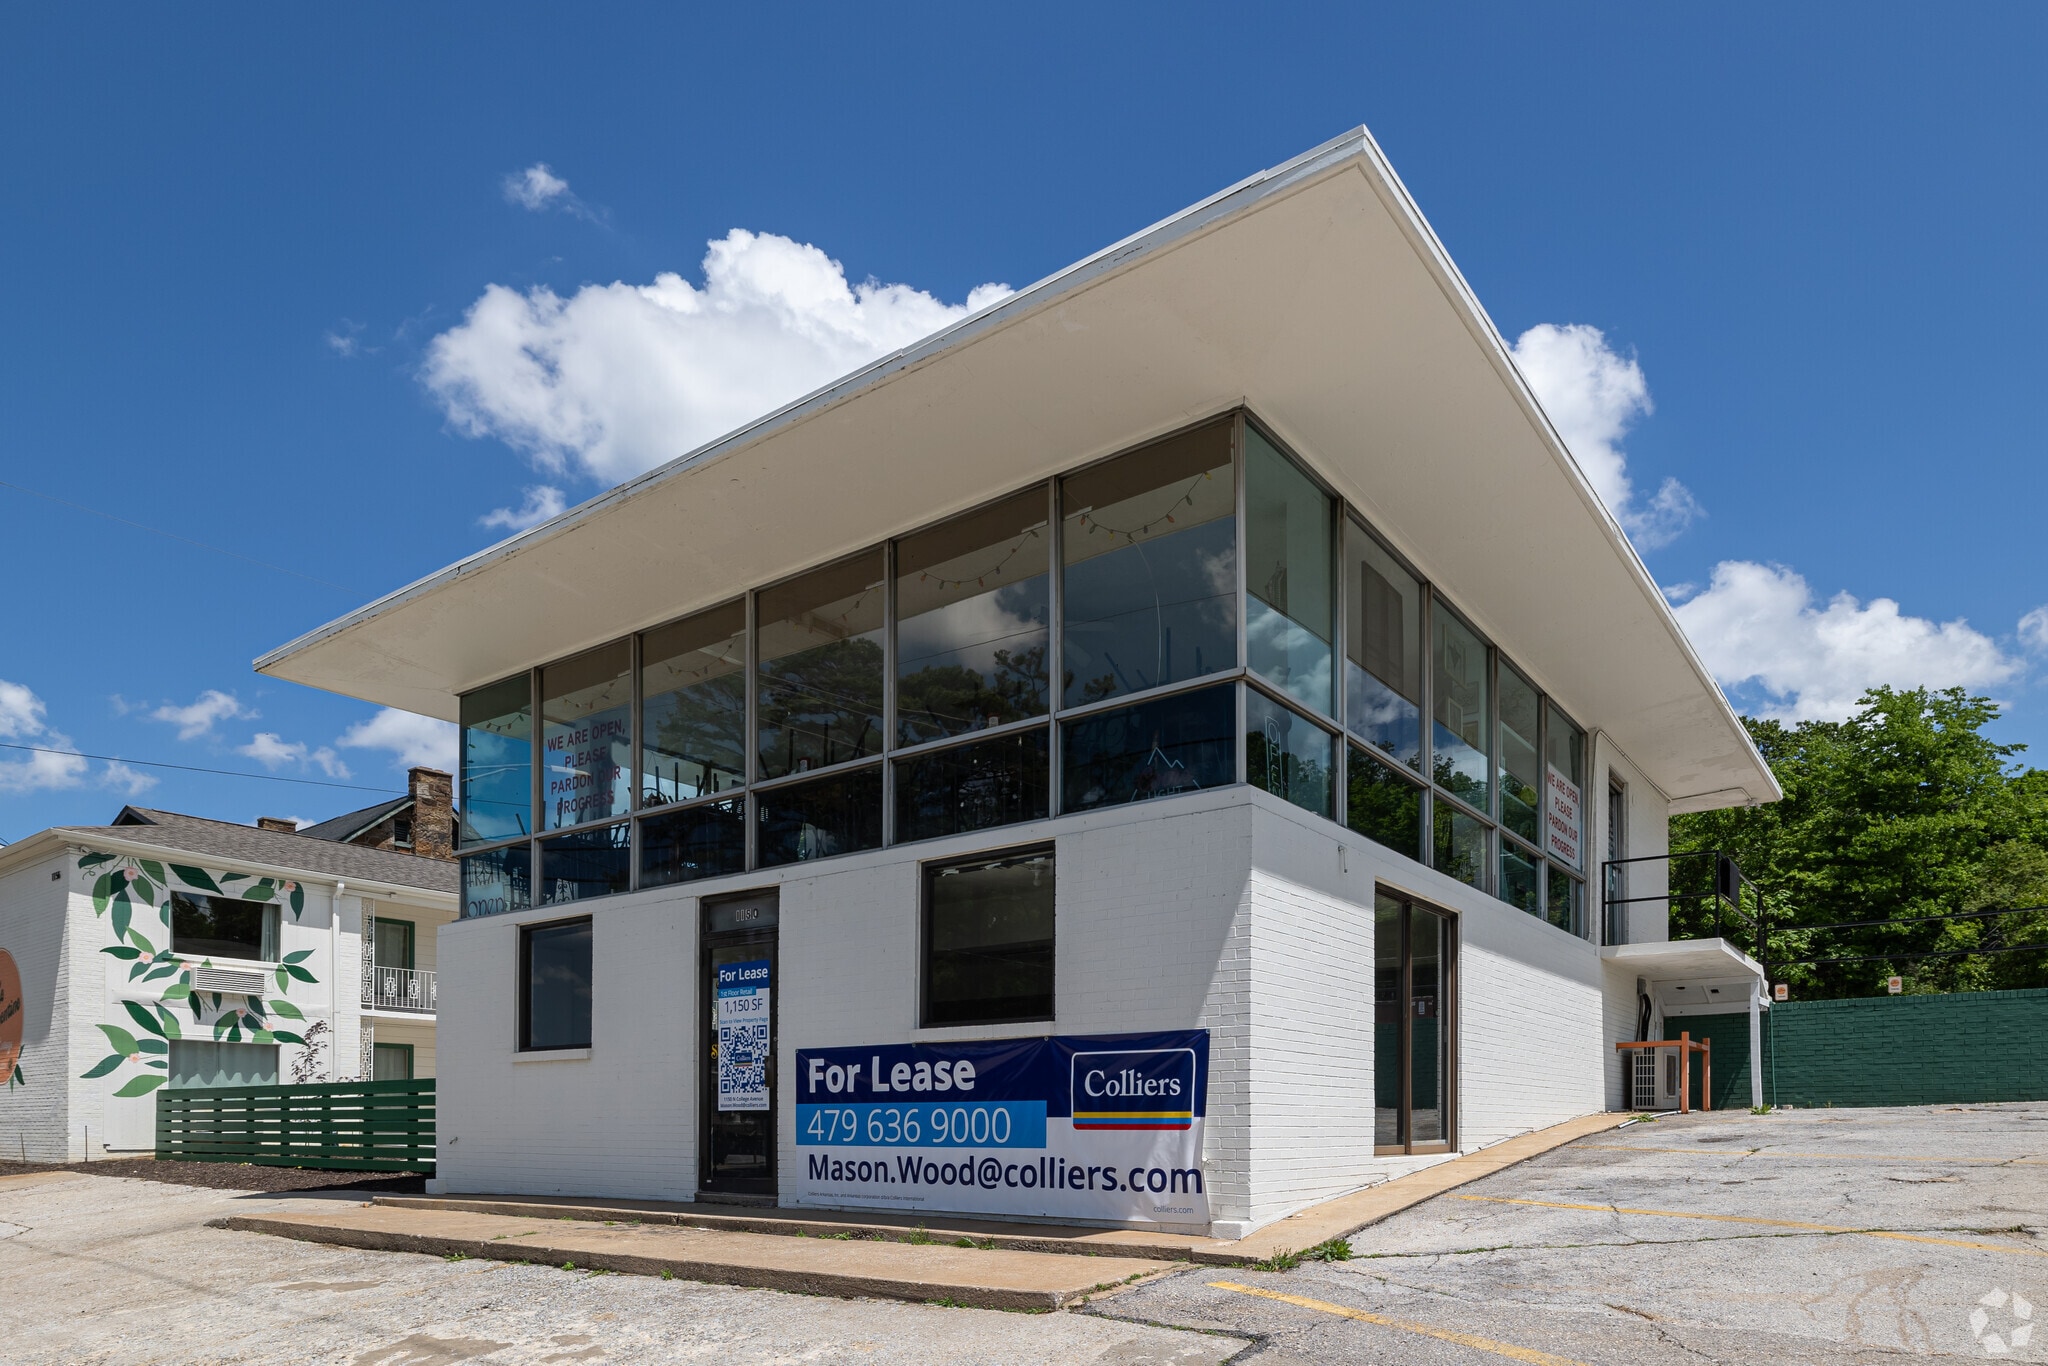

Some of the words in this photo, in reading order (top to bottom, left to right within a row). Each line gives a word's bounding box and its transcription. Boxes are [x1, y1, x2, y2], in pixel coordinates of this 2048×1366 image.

[548, 735, 564, 752] WE
[567, 728, 589, 747] ARE
[592, 719, 625, 740] OPEN,
[565, 746, 607, 769] PLEASE
[551, 775, 594, 795] PARDON
[599, 766, 621, 783] OUR
[1547, 772, 1556, 788] WE
[1556, 778, 1566, 796] ARE
[1566, 786, 1580, 808] OPEN,
[557, 790, 614, 816] PROGRESS
[1555, 797, 1573, 820] PLEASE
[1549, 813, 1568, 836] PARDON
[1568, 826, 1578, 843] OUR
[1551, 834, 1576, 860] PROGRESS
[720, 970, 736, 982] For
[739, 968, 768, 980] Lease
[725, 999, 750, 1014] 1,150
[752, 998, 763, 1011] SF
[808, 1057, 860, 1094] For
[871, 1055, 976, 1093] Lease
[1084, 1069, 1181, 1097] Colliers
[807, 1109, 857, 1143] 479
[867, 1108, 921, 1143] 636
[931, 1107, 1011, 1144] 9000
[808, 1153, 1202, 1195] Mason.Wood@colliers.com
[1153, 1206, 1194, 1214] colliers.com
